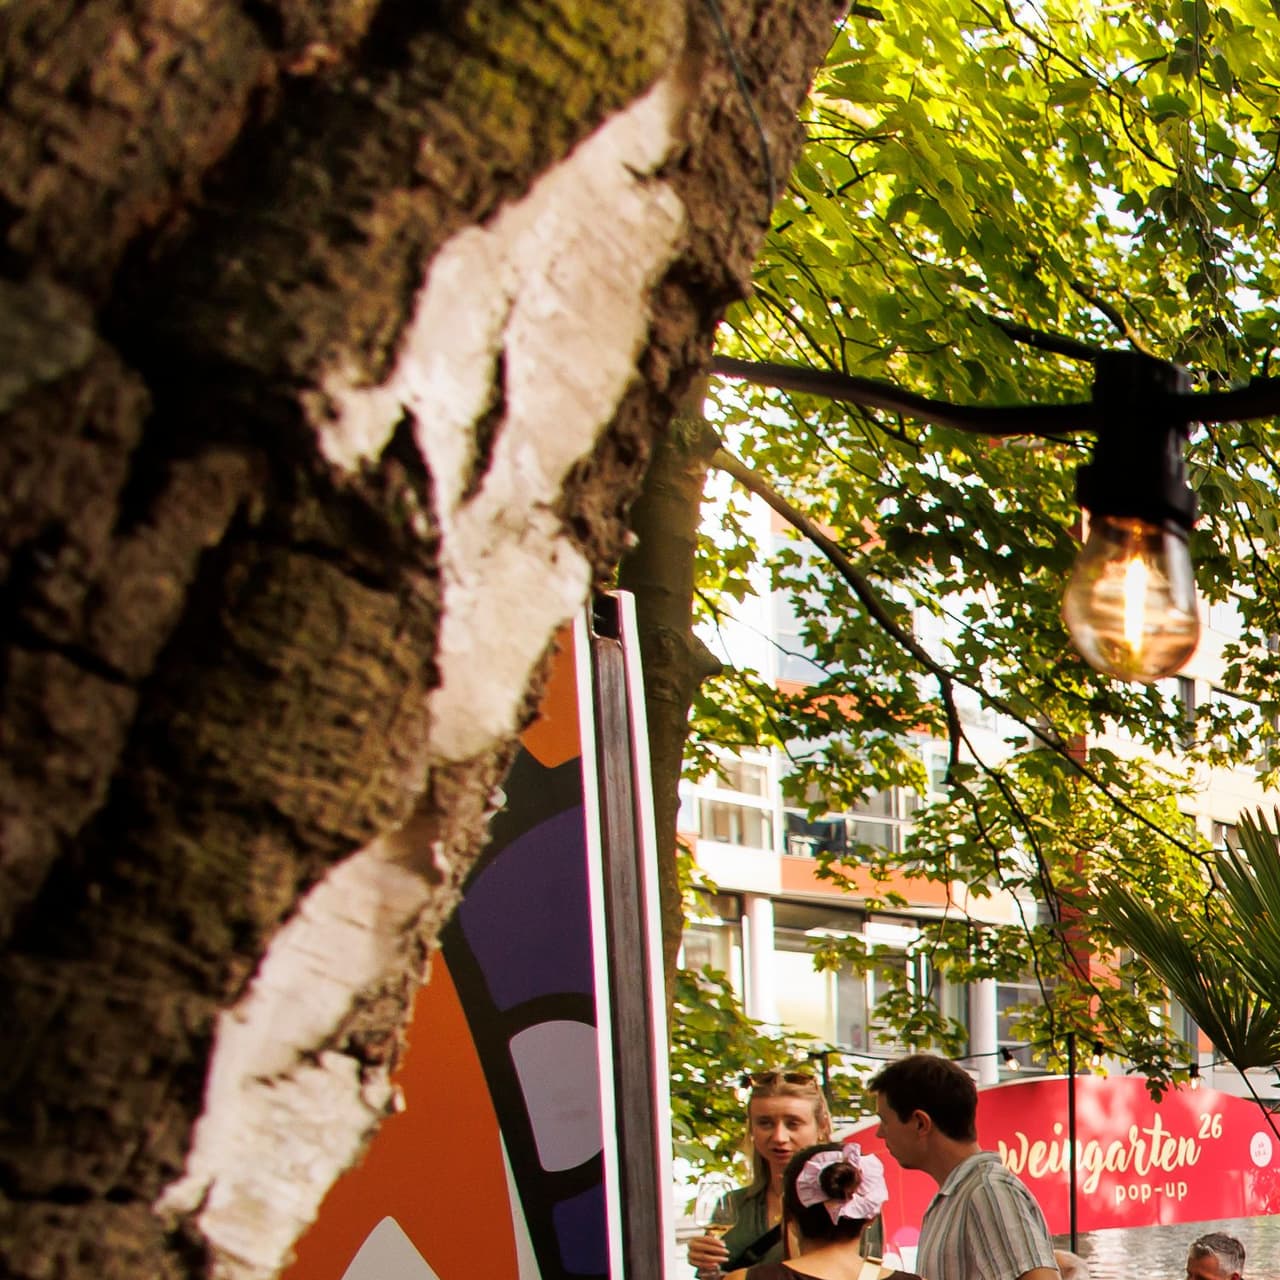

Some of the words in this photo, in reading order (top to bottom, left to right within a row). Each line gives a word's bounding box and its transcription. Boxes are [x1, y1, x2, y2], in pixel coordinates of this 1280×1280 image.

[998, 1112, 1202, 1195] weingarten
[1198, 1113, 1223, 1140] 26
[1115, 1181, 1188, 1204] pop-up
